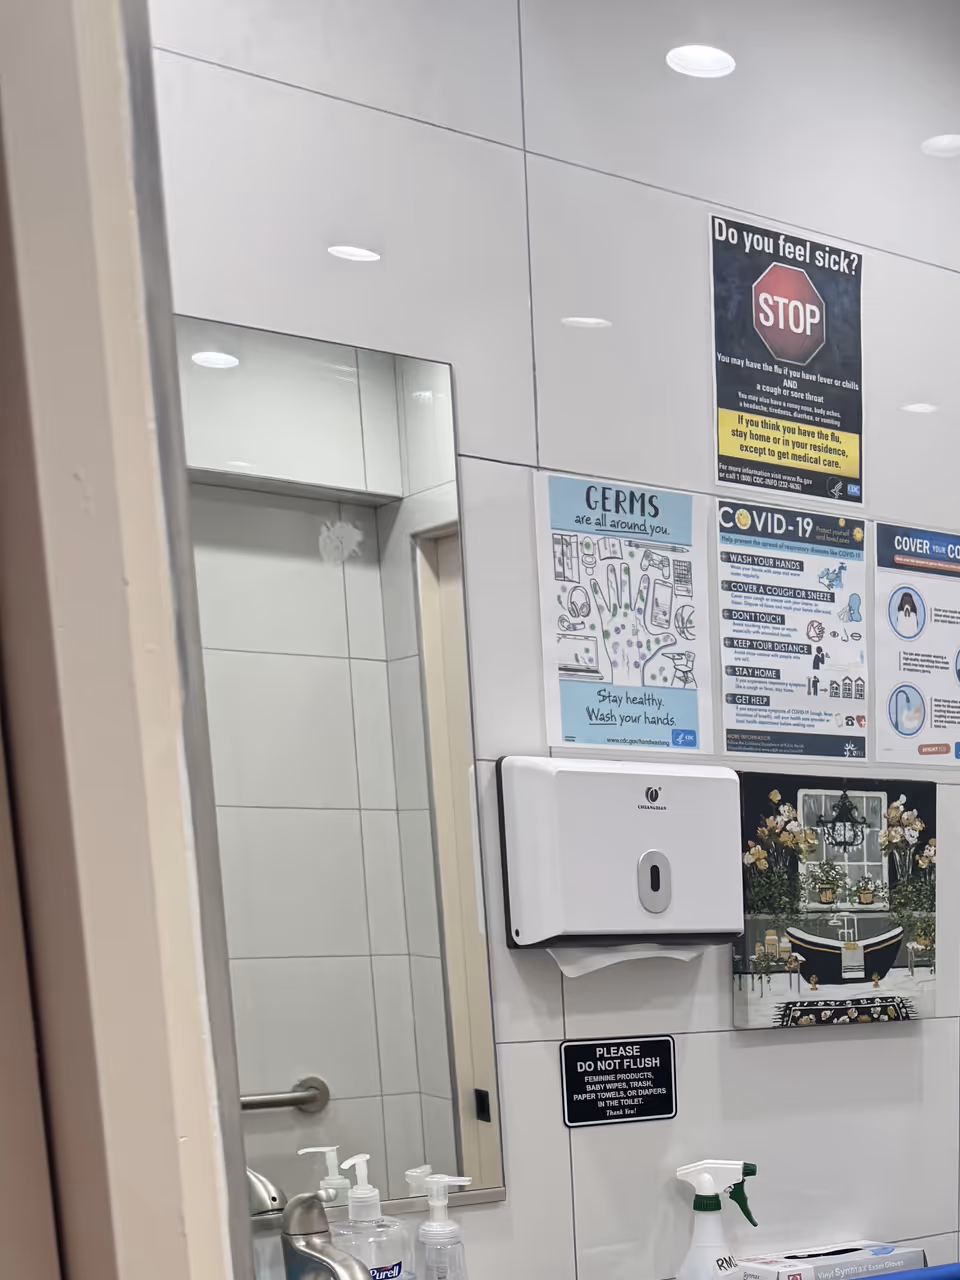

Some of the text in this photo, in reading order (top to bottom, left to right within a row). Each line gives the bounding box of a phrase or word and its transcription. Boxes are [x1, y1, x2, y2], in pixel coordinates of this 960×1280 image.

[714, 218, 858, 275] Do you feel sick?
[759, 292, 820, 335] STOP
[717, 352, 730, 363] You
[731, 357, 744, 367] may
[746, 359, 760, 370] have
[762, 363, 772, 372] the
[784, 366, 788, 374] if
[789, 369, 800, 378] you
[802, 370, 816, 381] have
[818, 374, 833, 384] fever
[842, 379, 859, 390] chills
[783, 379, 797, 388] AND
[762, 384, 781, 396] cough
[791, 390, 804, 399] sore
[806, 392, 824, 403] throat
[814, 407, 825, 416] body
[738, 415, 842, 444] If you think you have the flu,
[731, 429, 747, 441] stay
[749, 430, 770, 443] home
[782, 436, 789, 446] in
[791, 440, 808, 450] your
[810, 442, 848, 458] residence,
[740, 444, 841, 469] except to get medical care.
[742, 467, 770, 477] information
[585, 485, 660, 518] GERMS
[575, 513, 670, 536] are all around you.
[719, 506, 813, 538] COVID-19
[894, 536, 930, 554] COVER
[932, 545, 946, 554] YOUR
[730, 554, 800, 570] WASH YOUR HANDS
[731, 582, 757, 593] COVER
[759, 585, 765, 594] A
[767, 586, 794, 597] COUGH
[796, 590, 806, 599] OR
[808, 591, 831, 601] SNEEZE
[732, 611, 781, 623] DON'T TOUCH
[733, 639, 808, 654] KEEP YOUR DISTANCE
[736, 668, 776, 678] STAY HOME
[597, 688, 665, 710] Stay healthy.
[586, 706, 676, 726] Wash your hands.
[596, 1045, 640, 1058] PLEASE
[577, 1057, 660, 1072] DO NOT FLUSH
[617, 1072, 654, 1080] PRODUCTS,
[370, 1266, 399, 1280] Purell
[818, 1260, 904, 1280] Vinyl Synmax Exam Gloves
